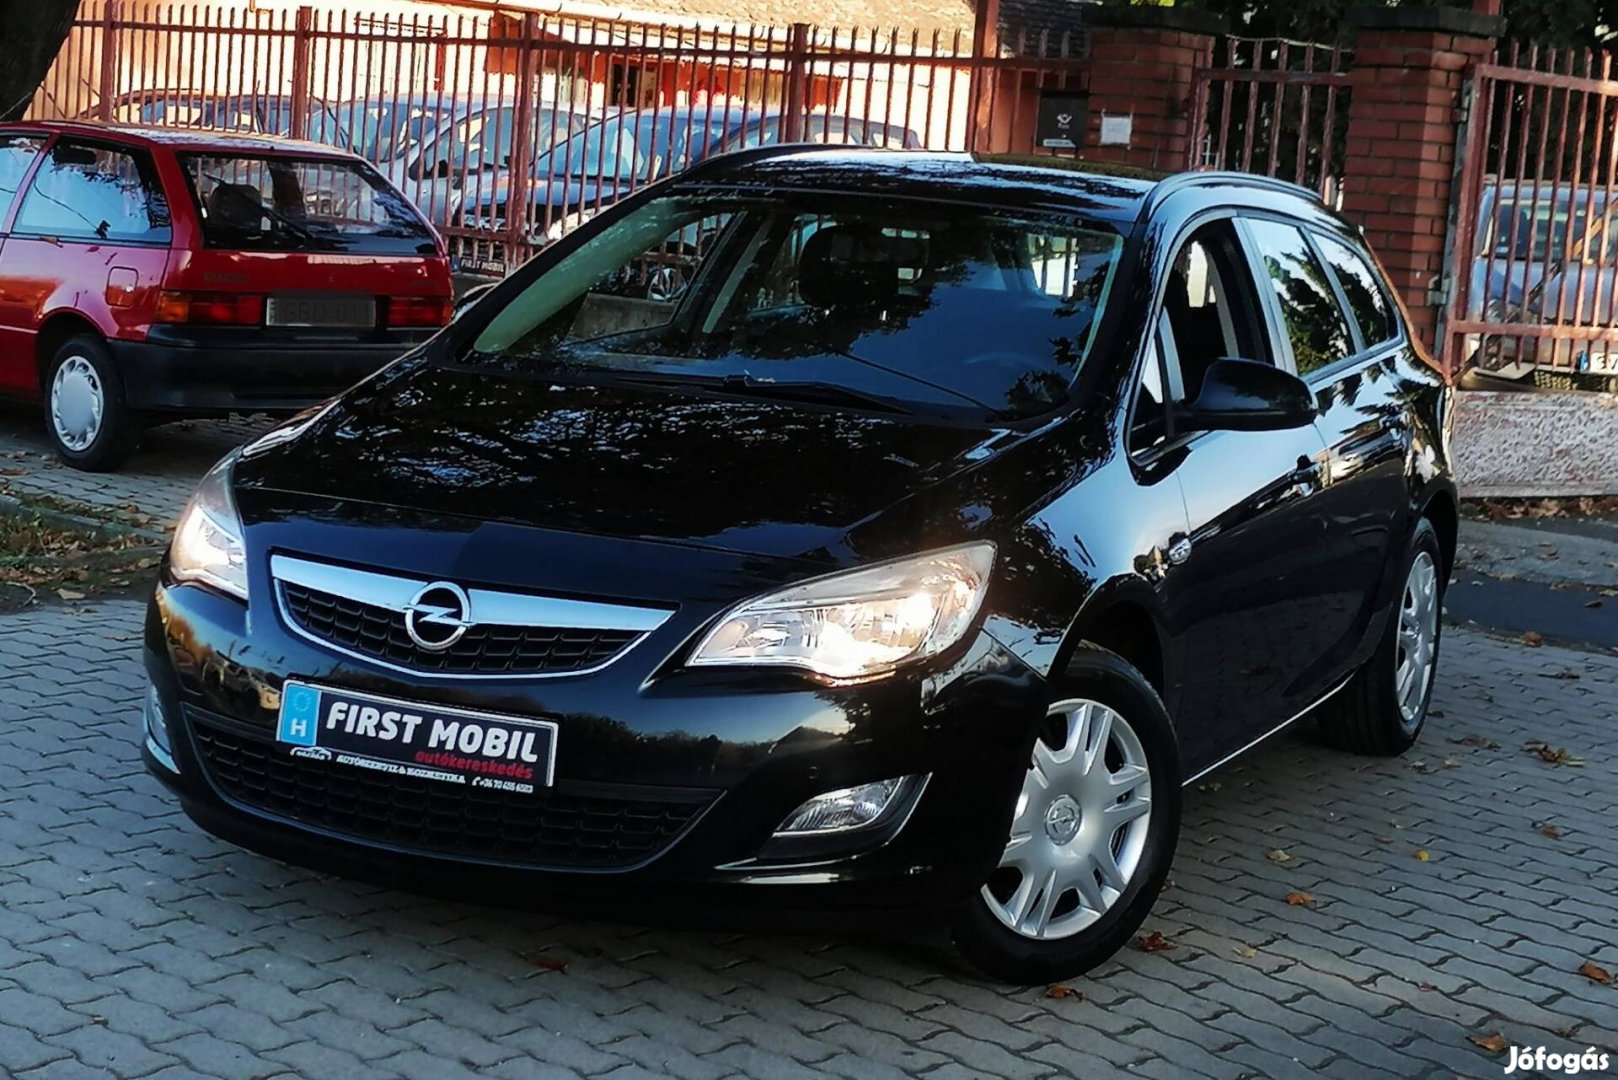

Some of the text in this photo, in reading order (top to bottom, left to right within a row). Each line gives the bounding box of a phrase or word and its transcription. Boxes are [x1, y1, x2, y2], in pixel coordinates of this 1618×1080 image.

[290, 718, 307, 737] H
[326, 701, 538, 763] FIRST MOBIL
[415, 750, 533, 779] autókereskedés
